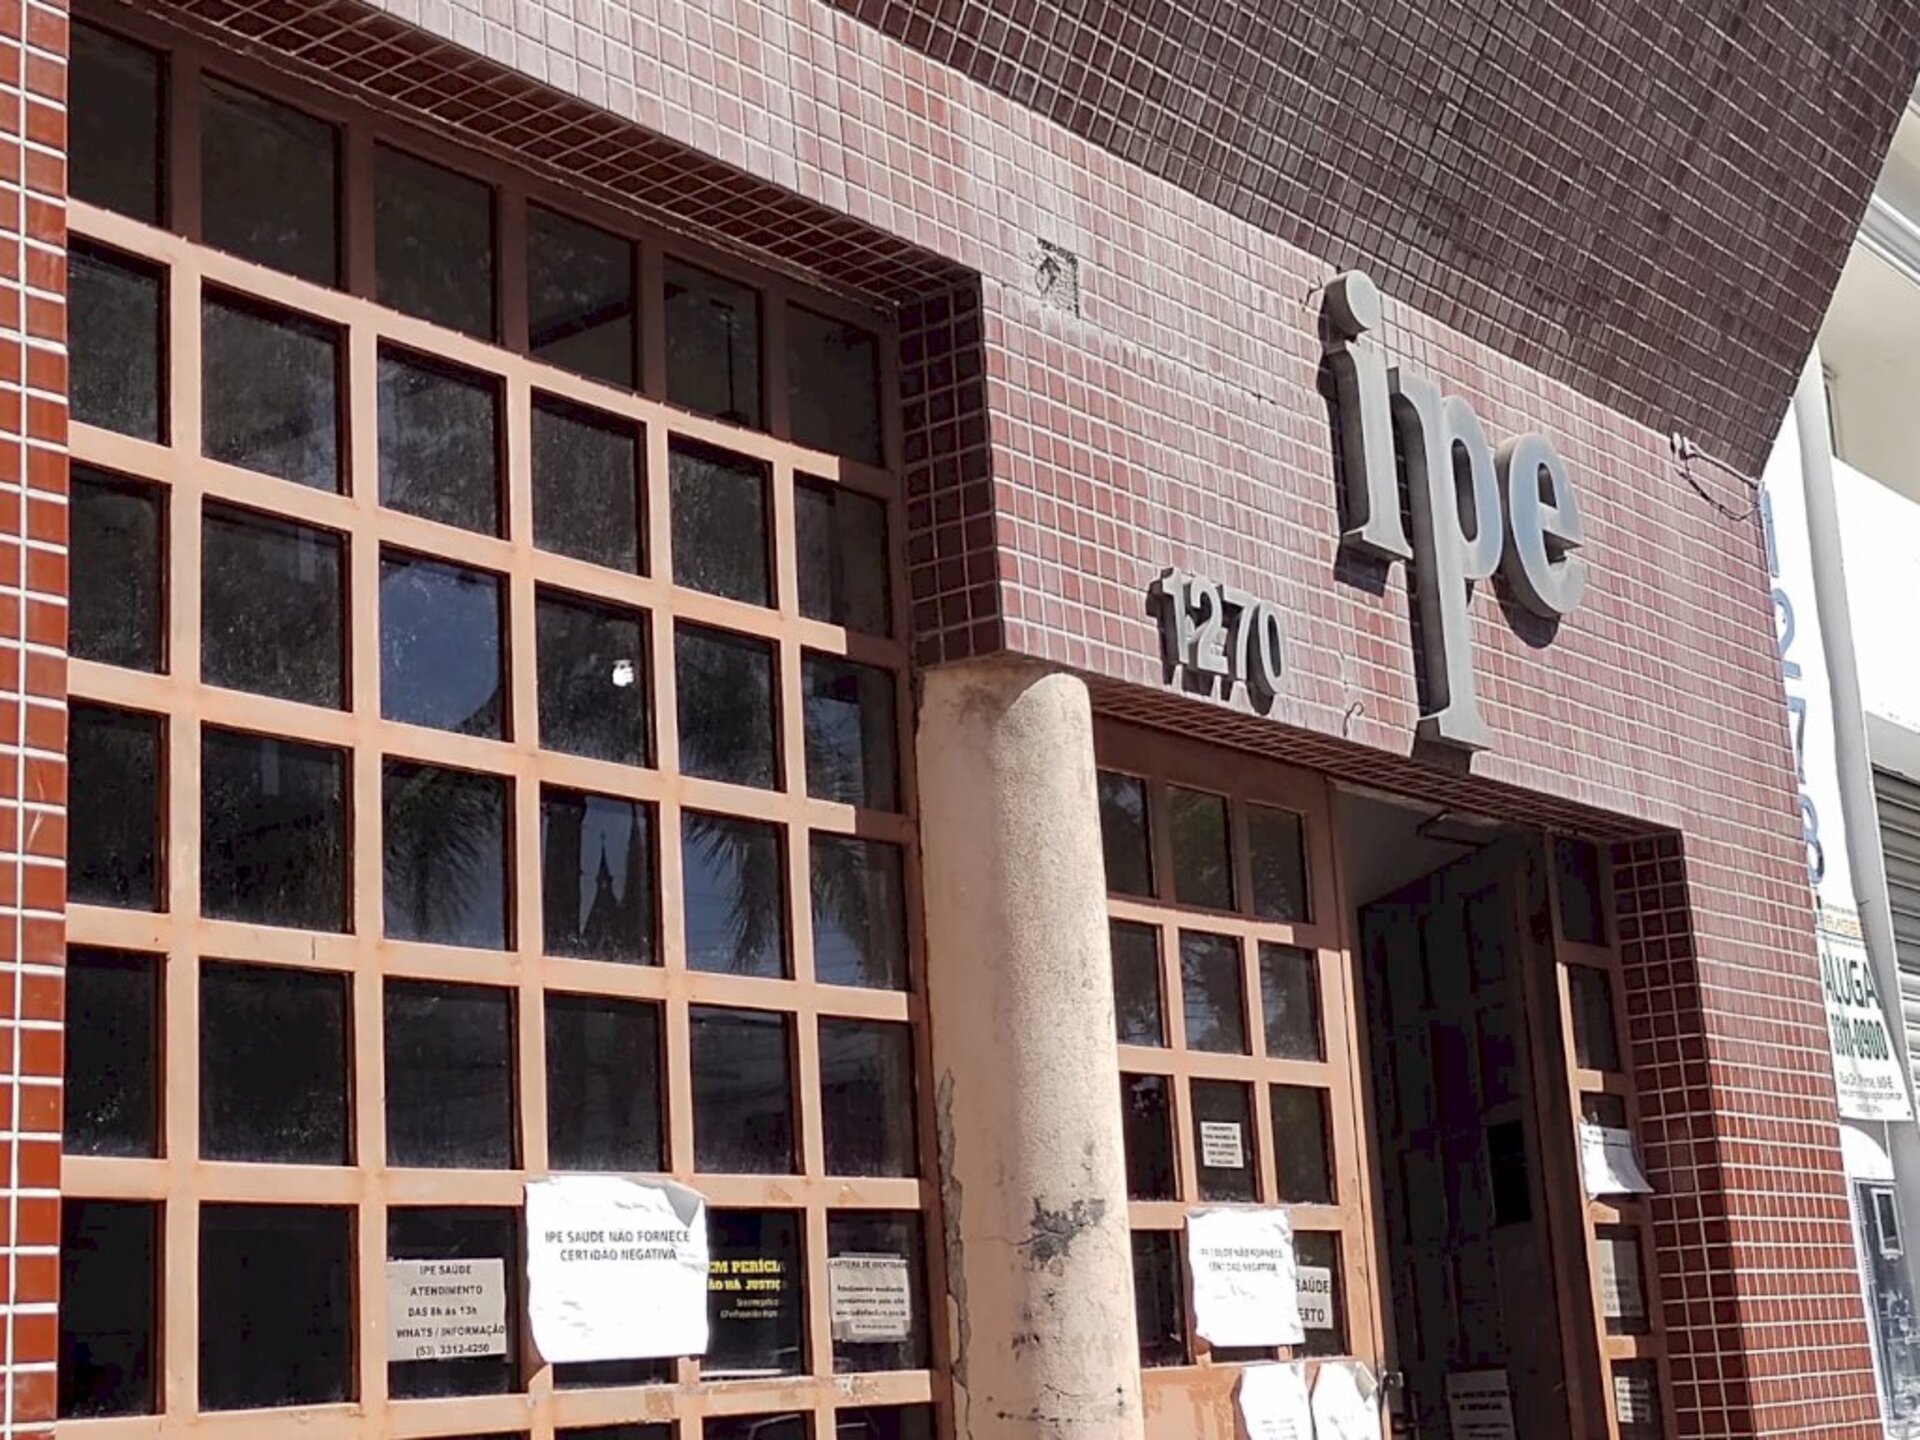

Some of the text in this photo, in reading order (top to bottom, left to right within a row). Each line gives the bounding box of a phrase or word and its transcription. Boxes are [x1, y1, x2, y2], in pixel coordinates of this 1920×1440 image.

[1322, 269, 1590, 752] ipe
[1162, 568, 1289, 694] 1270
[1822, 952, 1882, 1010] ALUGA
[545, 1231, 563, 1243] IPE
[637, 1230, 690, 1242] FORNECE
[621, 1248, 677, 1261] NEGATIVA
[420, 1265, 436, 1275] IPE
[708, 1260, 728, 1273] EM
[410, 1285, 483, 1296] ATENDIMENTO
[408, 1307, 428, 1317] DAS
[460, 1306, 477, 1315] 13h
[396, 1327, 433, 1338] WHATS
[441, 1322, 505, 1337] INFORMAÇÃO
